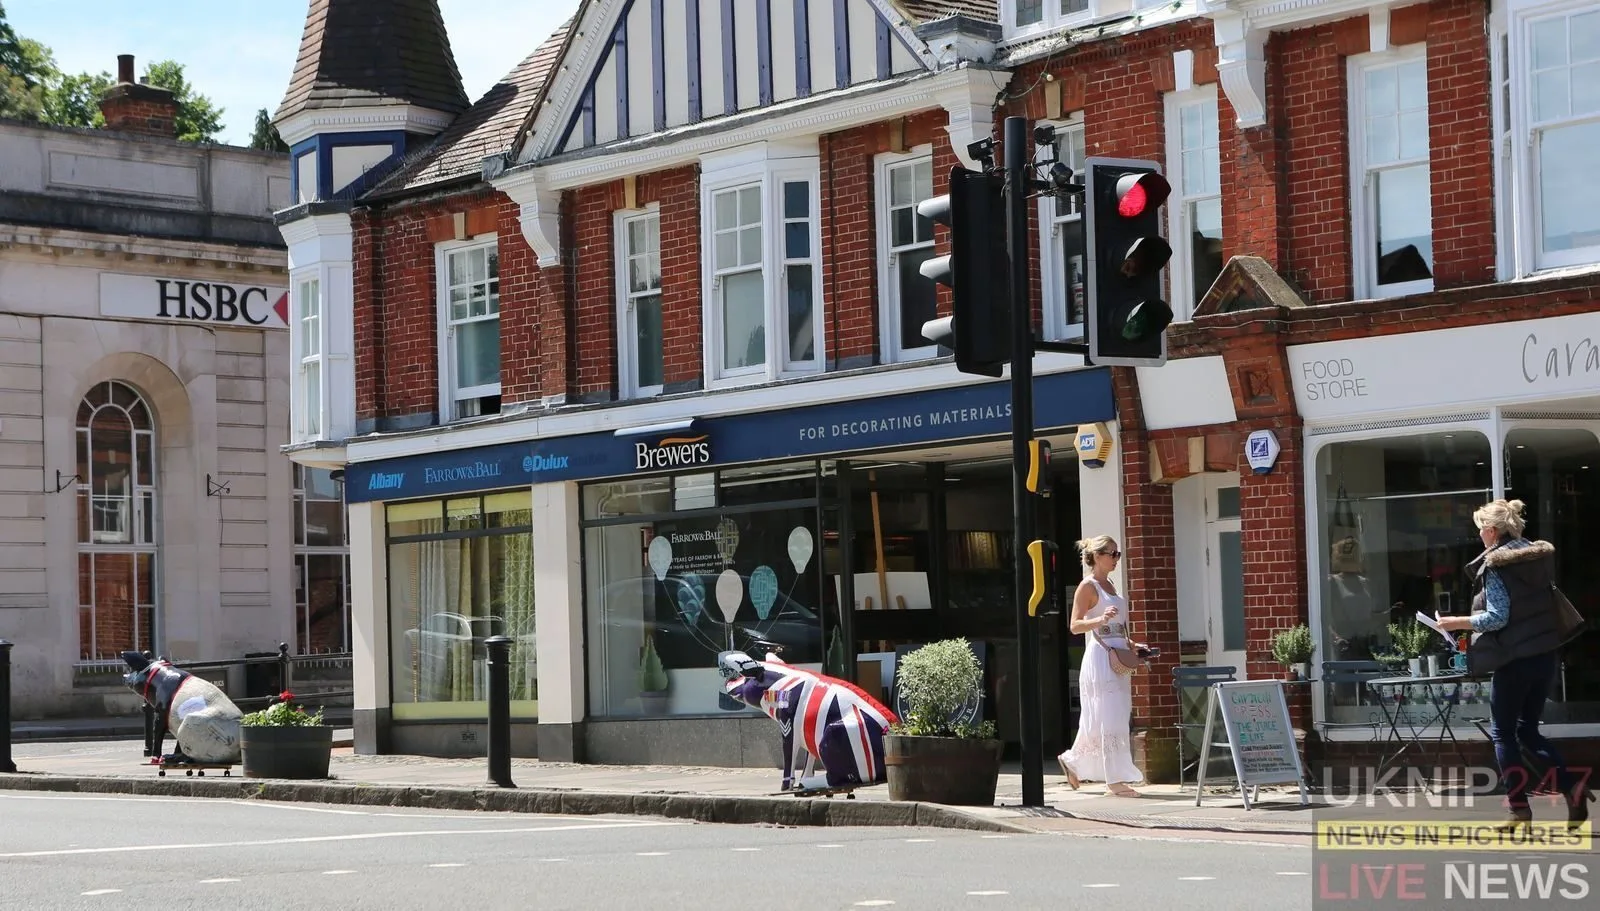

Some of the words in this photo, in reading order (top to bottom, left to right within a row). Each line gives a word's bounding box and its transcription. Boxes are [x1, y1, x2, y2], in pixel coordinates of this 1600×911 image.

[156, 279, 269, 324] HSBC
[1302, 358, 1354, 380] FOOD
[1306, 378, 1369, 401] STORE
[799, 426, 825, 441] FOR
[831, 414, 923, 437] DECORATING
[929, 403, 1012, 426] MATERIALS
[1080, 435, 1096, 448] ADT
[533, 454, 569, 472] Dulux
[635, 441, 710, 470] Brewers
[368, 472, 404, 490] Albany
